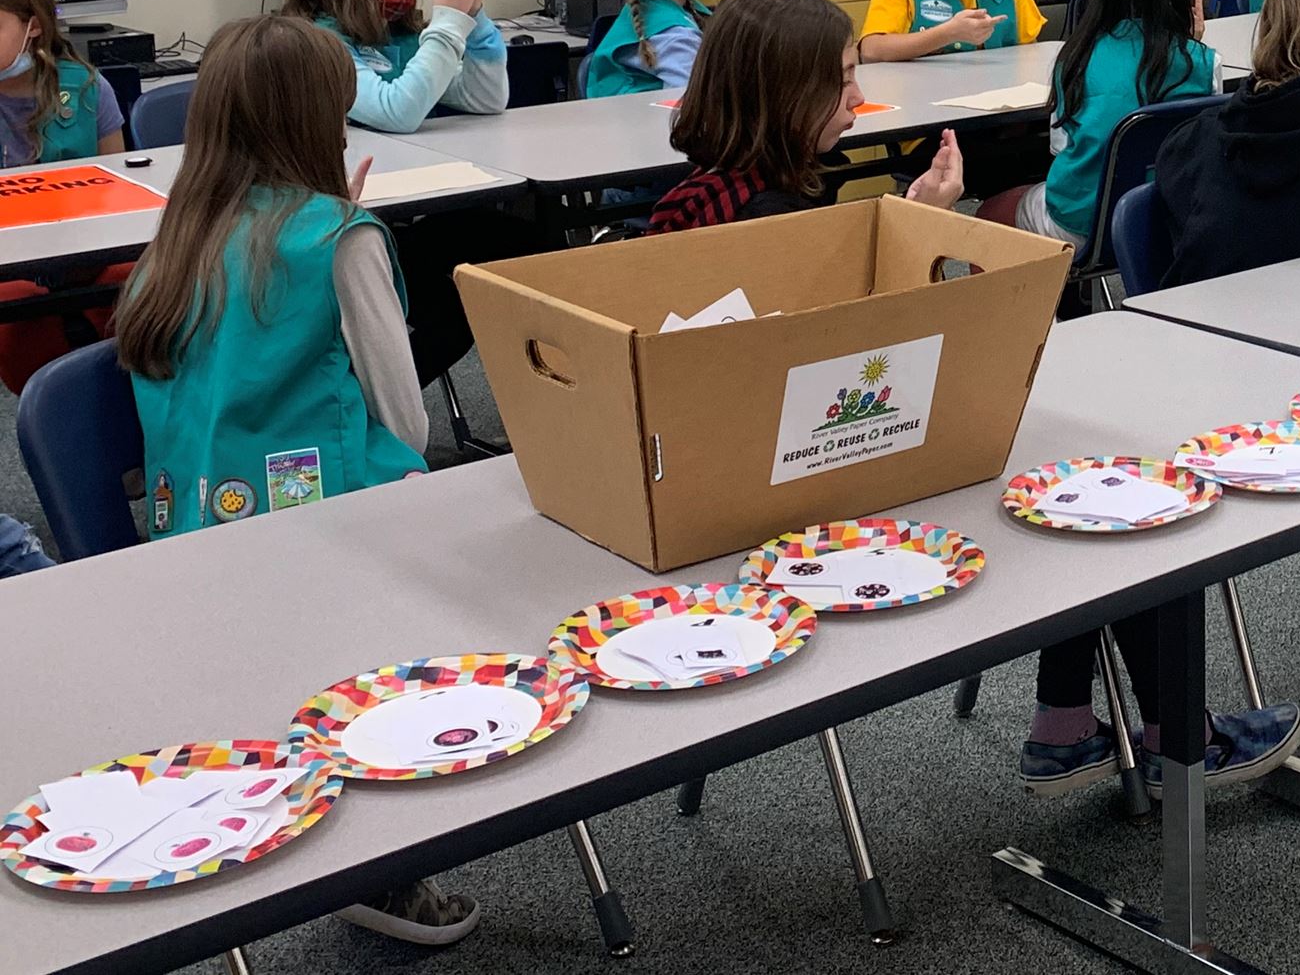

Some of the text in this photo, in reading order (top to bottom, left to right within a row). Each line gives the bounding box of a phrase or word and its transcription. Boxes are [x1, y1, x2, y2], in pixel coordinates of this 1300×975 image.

[782, 419, 921, 464] REDUCE REUSE RECYCLE
[811, 414, 899, 440] River Valley Paper Company
[806, 441, 893, 470] www.RiverValleyPaper.com
